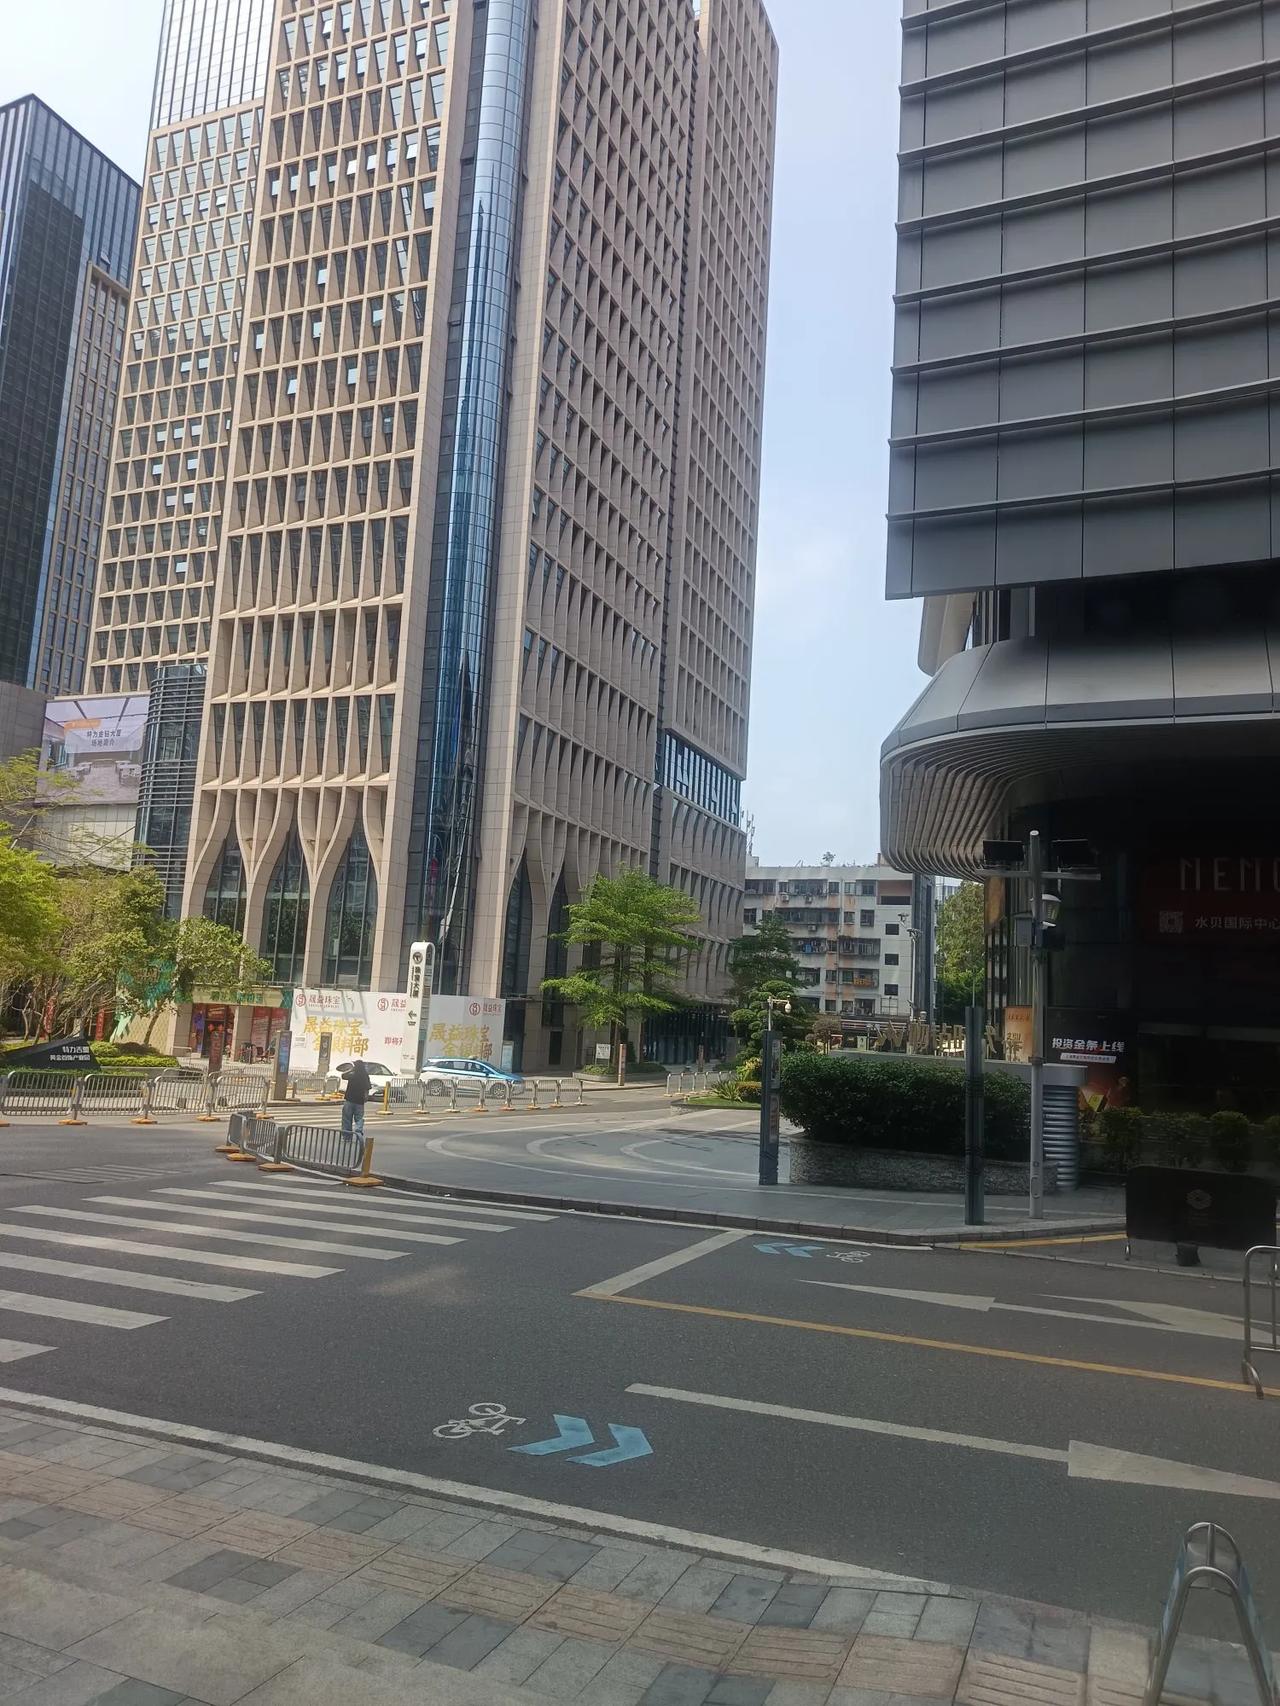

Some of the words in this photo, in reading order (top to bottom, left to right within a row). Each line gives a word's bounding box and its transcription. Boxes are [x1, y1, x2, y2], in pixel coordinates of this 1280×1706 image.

[1052, 1037, 1125, 1052] 投资金条上线
